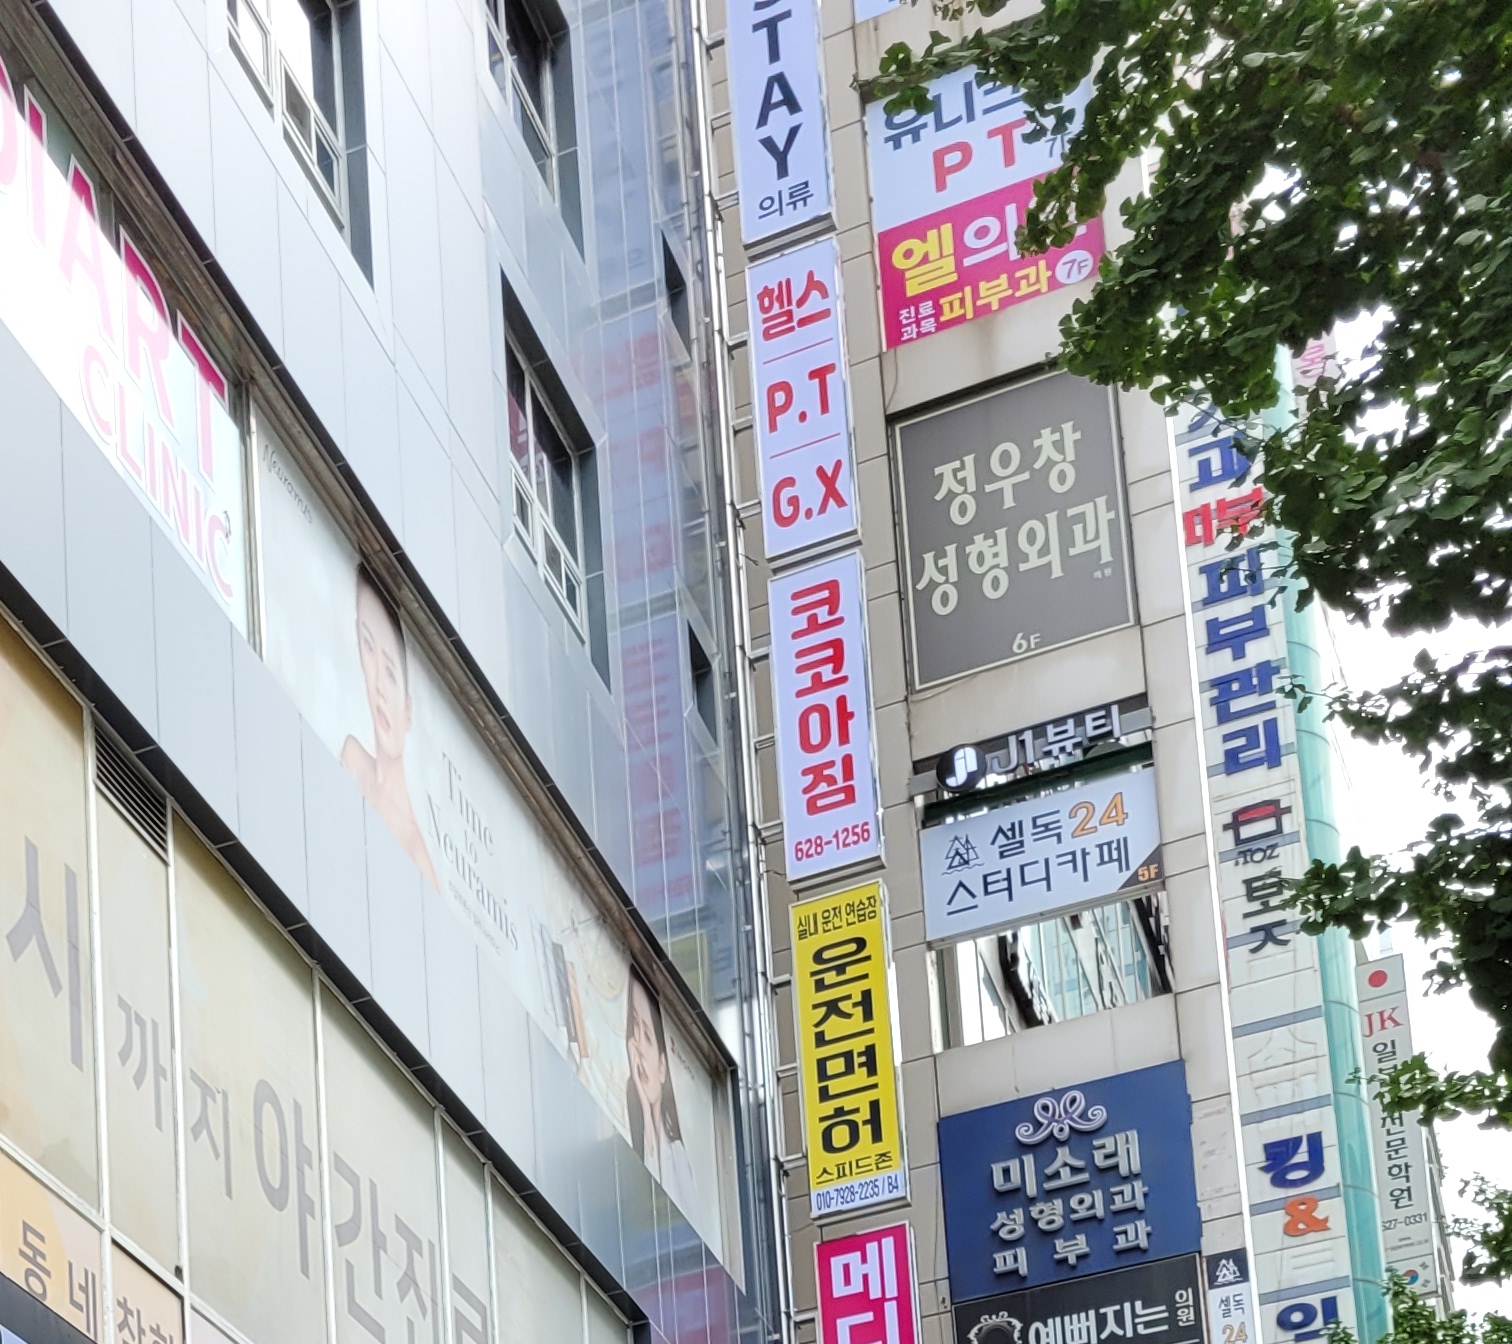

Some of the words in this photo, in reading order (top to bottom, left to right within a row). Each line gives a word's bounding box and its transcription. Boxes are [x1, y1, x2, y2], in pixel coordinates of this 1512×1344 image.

[757, 180, 814, 220] 의류
[939, 259, 1053, 321] 피부과
[1062, 258, 1089, 280] 7F
[756, 270, 832, 343] 헬스
[899, 301, 935, 323] 진료
[900, 317, 937, 341] 과목
[766, 363, 837, 434] P.T
[81, 345, 233, 598] CLINIC
[770, 459, 849, 530] G.X
[934, 421, 1082, 526] 정우창
[916, 495, 1115, 616] 성형외과
[1012, 632, 1041, 653] 6F
[1200, 545, 1282, 776] 피부관리
[789, 578, 857, 817] 코코아짐
[442, 752, 494, 857] Time
[990, 792, 1128, 860] 셀독24
[426, 790, 518, 951] Neuramis
[793, 821, 871, 862] 628-1256
[1138, 863, 1159, 881] 5F
[946, 836, 1131, 917] 스터디카페
[797, 912, 819, 941] 실내
[822, 905, 843, 934] 운전
[845, 895, 877, 927] 연습장
[809, 936, 884, 1154] 운전면허
[1363, 1006, 1404, 1037] JK
[816, 1151, 893, 1185] 스피드존
[990, 1129, 1142, 1198] 미소래
[1259, 1131, 1325, 1188] 킹
[989, 1180, 1149, 1241] 성형외과
[992, 1220, 1153, 1278] 피부과
[1175, 1287, 1194, 1326] 의원
[1219, 1293, 1245, 1318] 셀독
